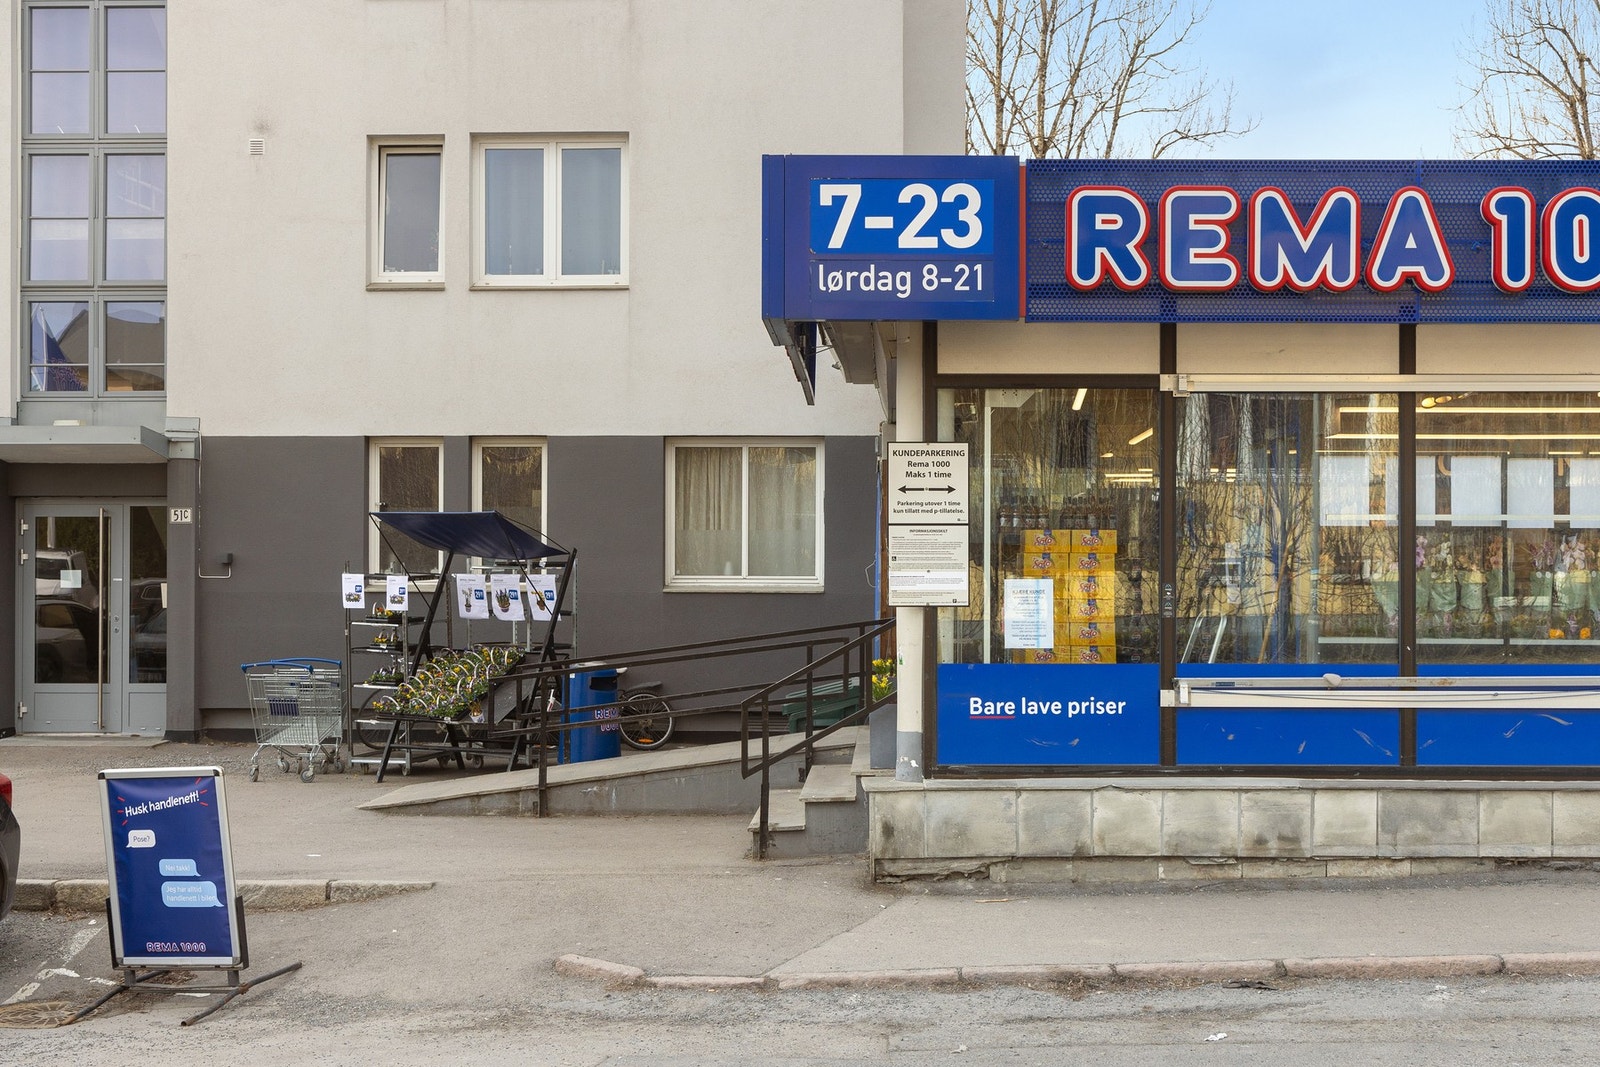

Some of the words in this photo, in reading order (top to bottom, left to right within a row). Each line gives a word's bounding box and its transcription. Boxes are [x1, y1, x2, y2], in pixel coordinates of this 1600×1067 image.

[819, 183, 983, 249] 7-23
[1065, 185, 1455, 293] REMA
[818, 264, 911, 299] lørdag
[922, 263, 983, 291] 8-21
[892, 449, 965, 457] KUNDEPARKERING
[907, 460, 929, 468] Rema
[931, 460, 951, 468] 1000
[173, 509, 189, 522] 51C
[969, 697, 1015, 715] Bare
[1021, 697, 1062, 715] lave
[1067, 696, 1127, 718] priser
[125, 800, 149, 817] Husk
[149, 790, 200, 813] handlenett!
[133, 835, 151, 843] Pose?
[146, 942, 180, 953] REMA
[181, 942, 207, 952] 1000
